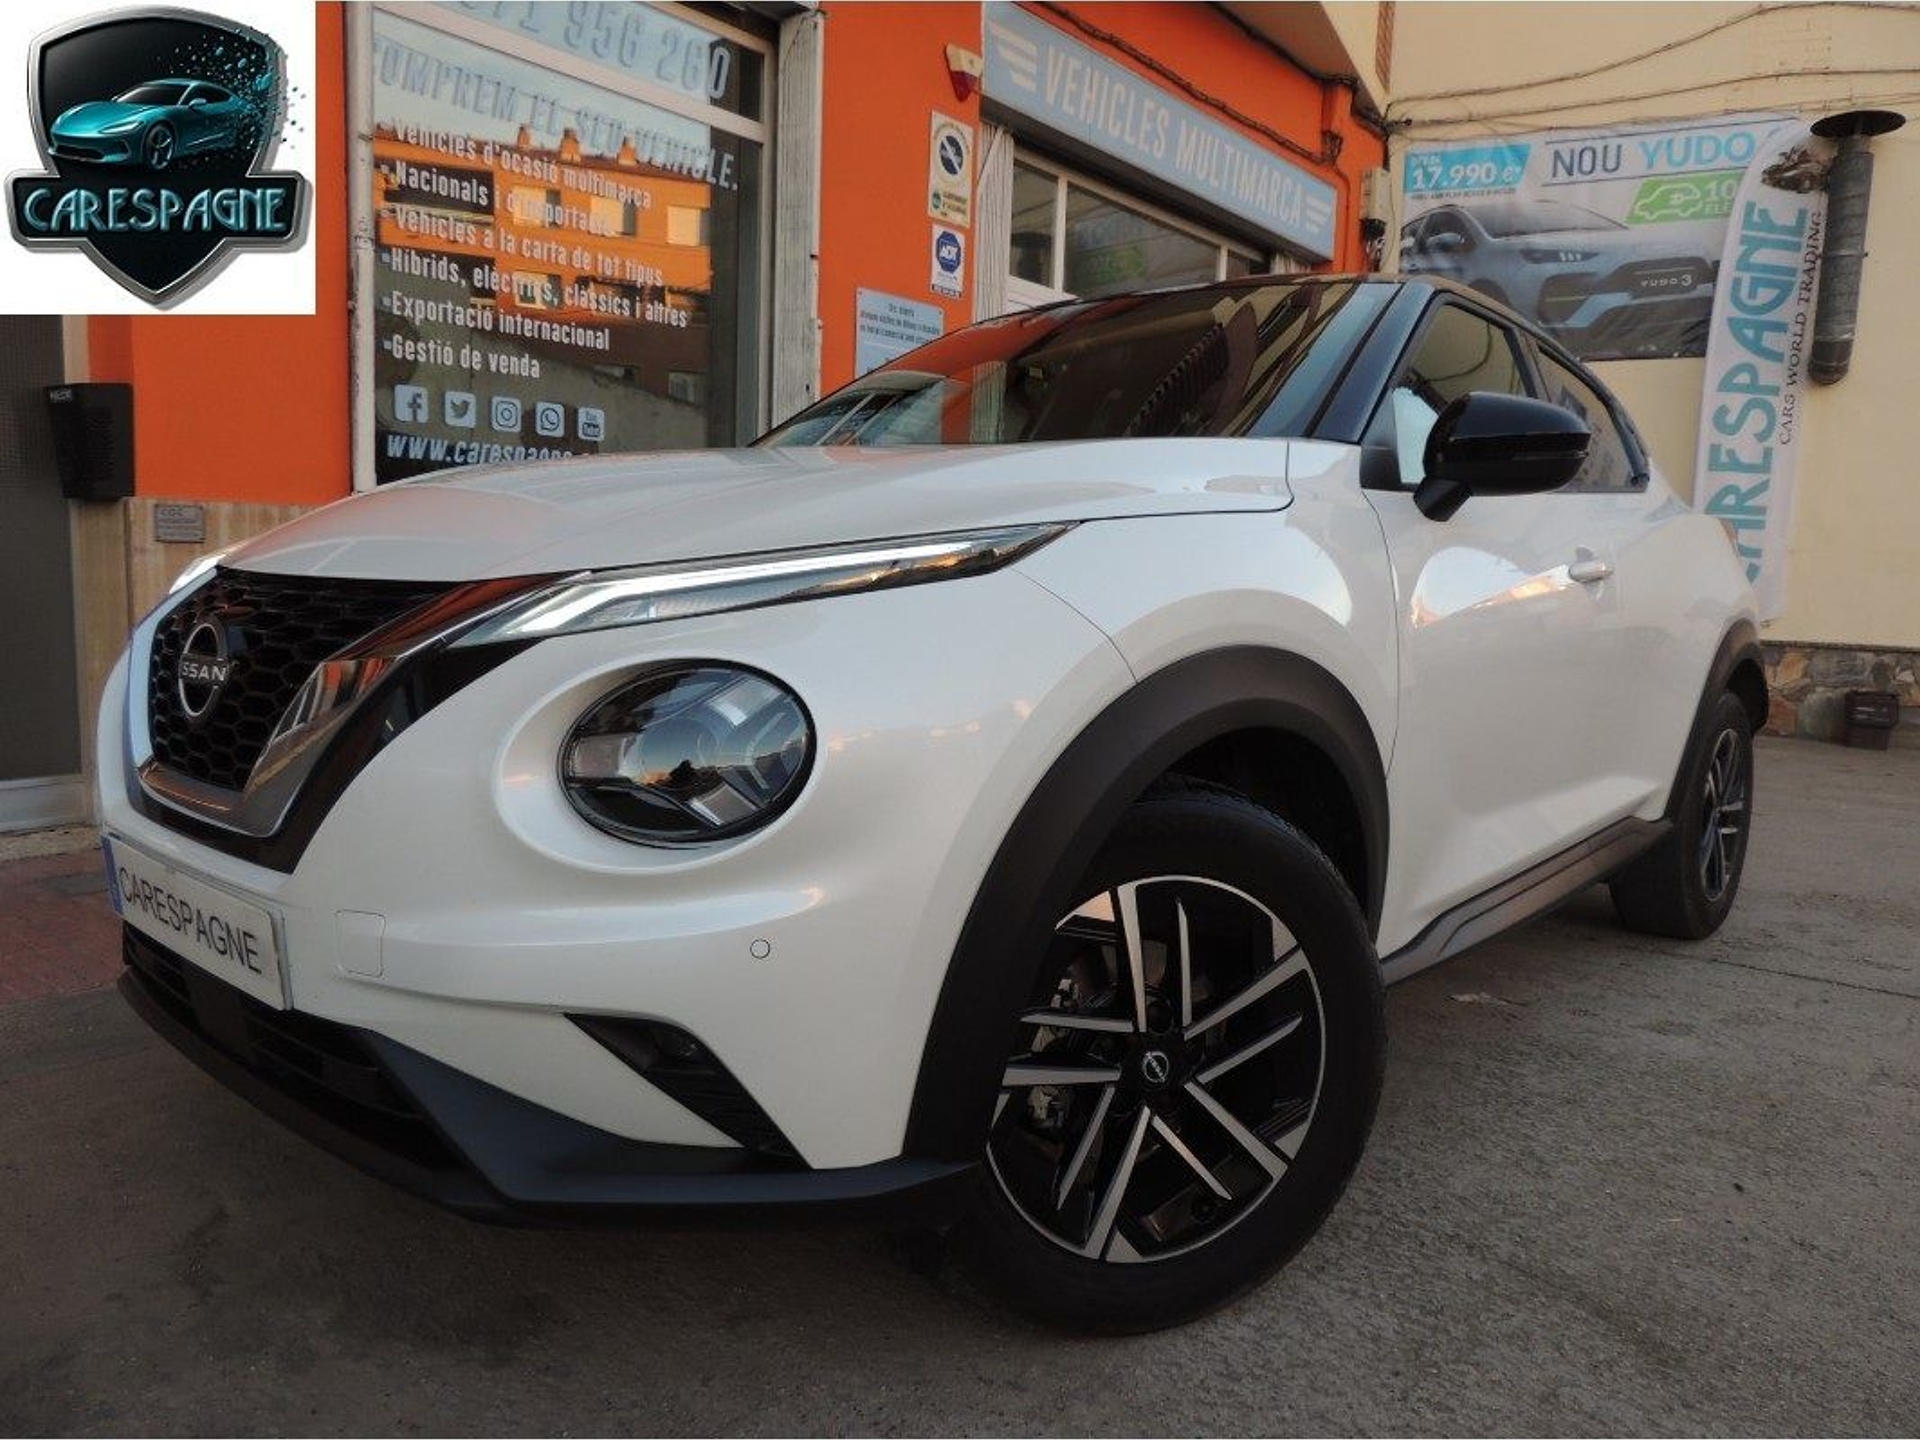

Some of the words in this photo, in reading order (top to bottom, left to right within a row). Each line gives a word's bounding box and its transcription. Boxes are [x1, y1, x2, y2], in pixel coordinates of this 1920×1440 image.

[374, 32, 518, 122] OMPREM
[656, 27, 731, 99] 260
[397, 120, 477, 161] Vehicles
[563, 166, 651, 210] multimarca
[1044, 43, 1171, 160] VEHICLES
[1174, 117, 1304, 225] MULTIMARCA
[1551, 142, 1623, 179] NOU
[1638, 131, 1758, 170] YUDO
[395, 160, 489, 207] Nacionals
[1411, 161, 1498, 190] 17.990
[396, 204, 478, 245] Vehicles
[483, 228, 494, 249] a
[500, 227, 516, 254] la
[521, 237, 568, 267] carta
[572, 246, 591, 271] de
[597, 253, 619, 276] tot
[625, 258, 664, 288] tipus
[1797, 211, 1822, 307] TRADING
[392, 290, 494, 332] Exportació
[499, 309, 610, 351] internacional
[645, 299, 688, 328] altres
[1786, 312, 1808, 388] WORLD
[391, 333, 454, 366] Gestió
[460, 343, 482, 371] de
[488, 353, 540, 379] venda
[1704, 200, 1810, 583] RESPAGNE
[1778, 392, 1797, 446] CARS
[117, 864, 263, 976] CARESPAGNE
